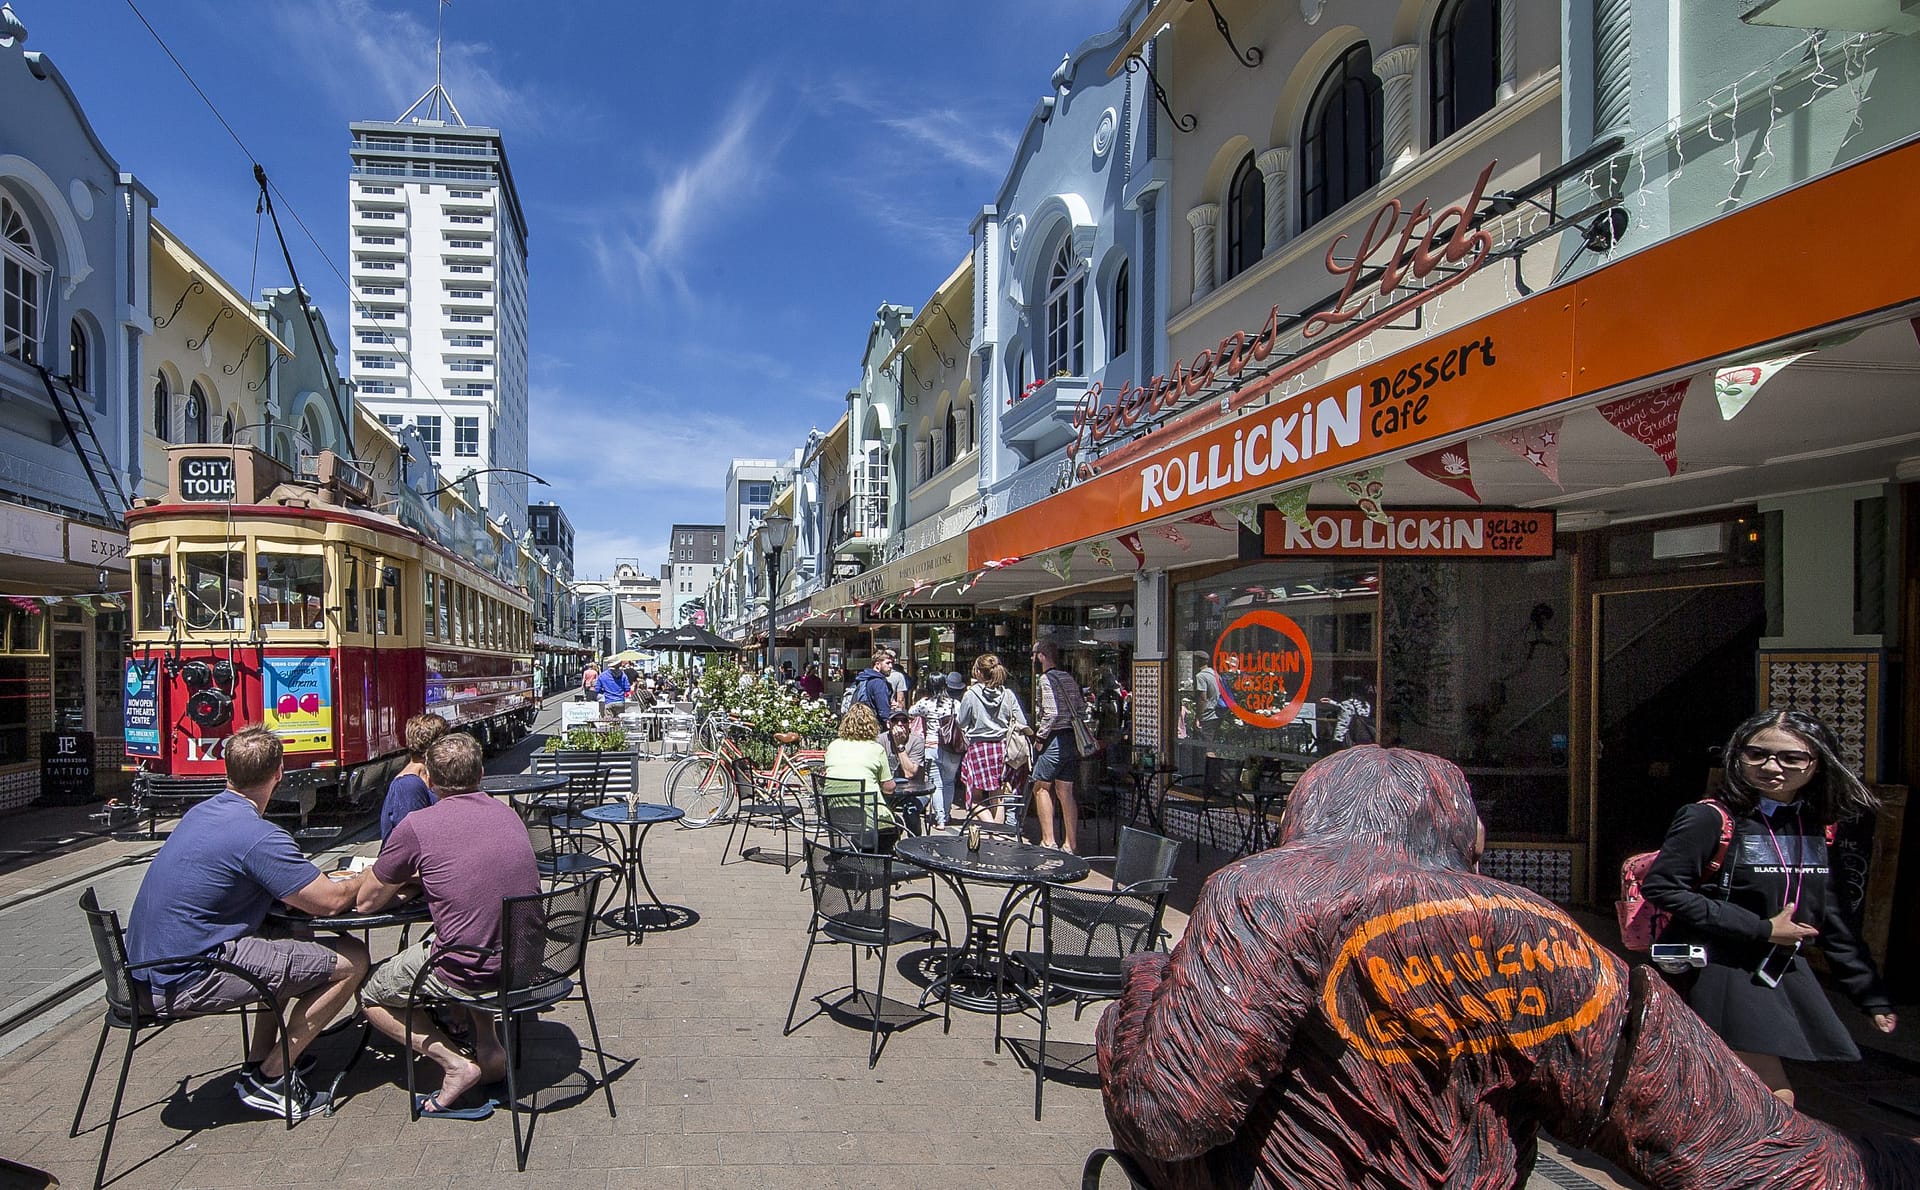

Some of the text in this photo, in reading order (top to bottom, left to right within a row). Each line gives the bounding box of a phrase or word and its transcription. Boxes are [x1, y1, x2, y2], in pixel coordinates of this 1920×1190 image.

[1066, 158, 1493, 462] Petersens Ltd
[1369, 336, 1496, 408] Dessert
[1371, 394, 1430, 439] cafe
[188, 461, 230, 476] CITY
[184, 479, 235, 494] TOUR
[1491, 535, 1523, 550] cafe
[140, 700, 153, 708] OPEN
[143, 708, 155, 717] ARTS
[131, 716, 151, 725] CENTRE
[47, 767, 89, 776] TATTOO
